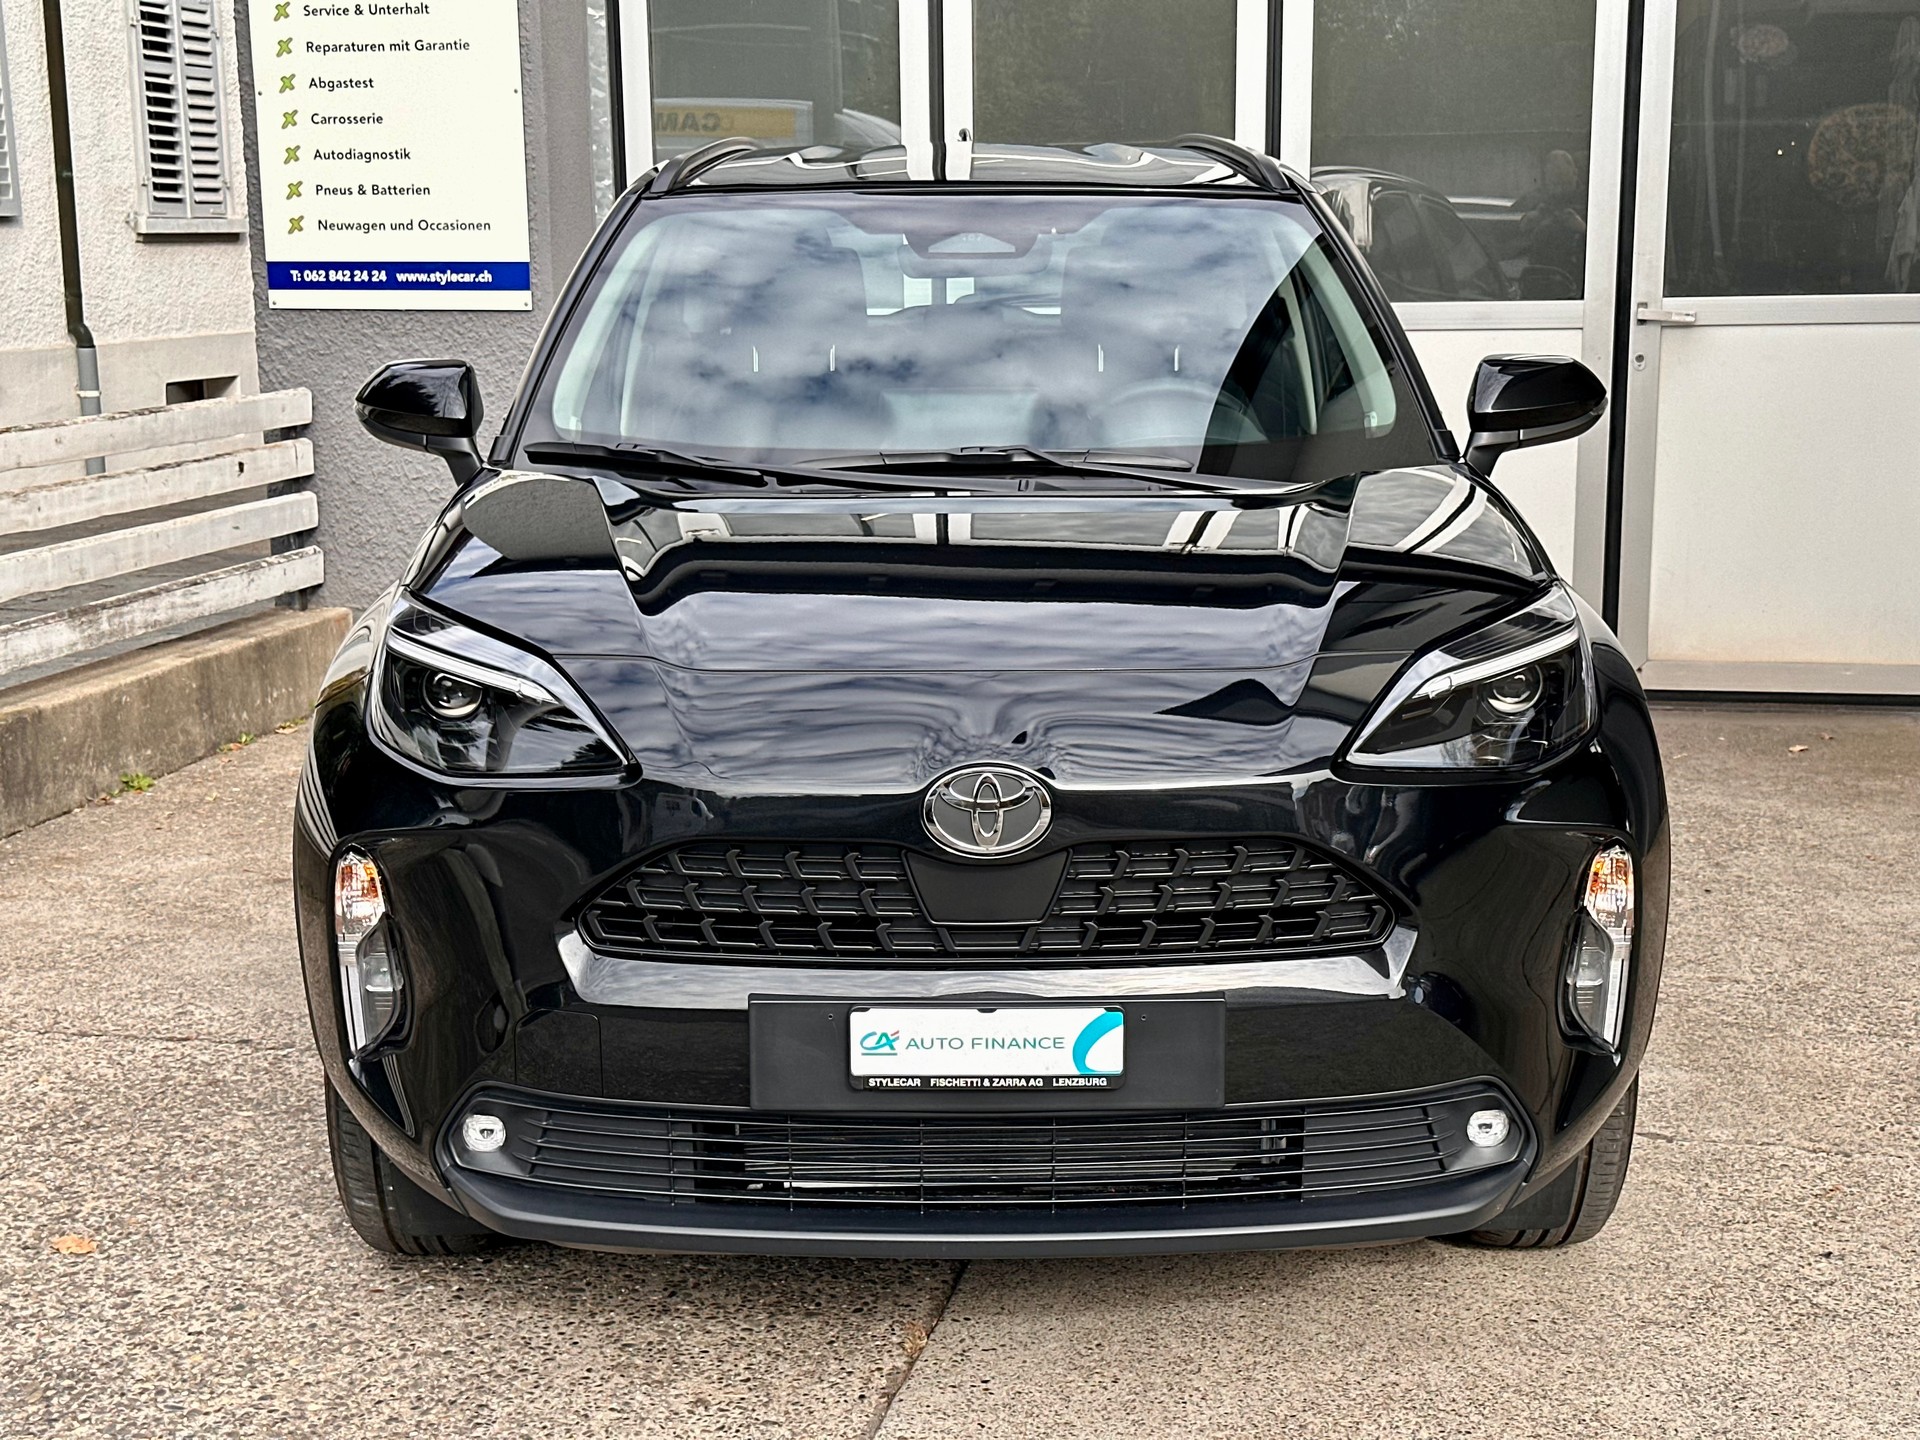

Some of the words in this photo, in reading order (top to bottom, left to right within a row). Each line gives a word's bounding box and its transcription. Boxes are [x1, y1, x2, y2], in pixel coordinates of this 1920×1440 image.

[303, 3, 350, 17] Service
[353, 3, 365, 16] &
[368, 1, 430, 16] Unterhalt
[305, 40, 386, 57] Reparaturen
[389, 39, 411, 52] mit
[414, 38, 470, 52] Garantie
[308, 76, 375, 93] Abgastest
[310, 112, 384, 125] Carrosserie
[313, 147, 411, 164] Autodiagnostik
[315, 184, 354, 196] Pneus
[357, 183, 367, 196] &
[371, 183, 431, 196] Batterien
[317, 219, 386, 235] Neuwagen
[389, 218, 414, 231] und
[417, 219, 491, 231] Occasionen
[289, 269, 302, 282] T:
[303, 269, 327, 282] 062
[328, 269, 352, 282] 842
[353, 269, 370, 283] 24
[371, 269, 388, 282] 24
[395, 269, 493, 286] www.stylecar.ch
[904, 1037, 965, 1050] AUTO
[971, 1036, 1065, 1050] FINANCE
[868, 1078, 921, 1087] STYLECAR
[930, 1078, 981, 1087] FISCHETTI
[983, 1078, 991, 1087] &
[992, 1078, 1027, 1087] ZARRA
[1028, 1078, 1044, 1087] AG
[1052, 1078, 1107, 1087] LENZBURG
